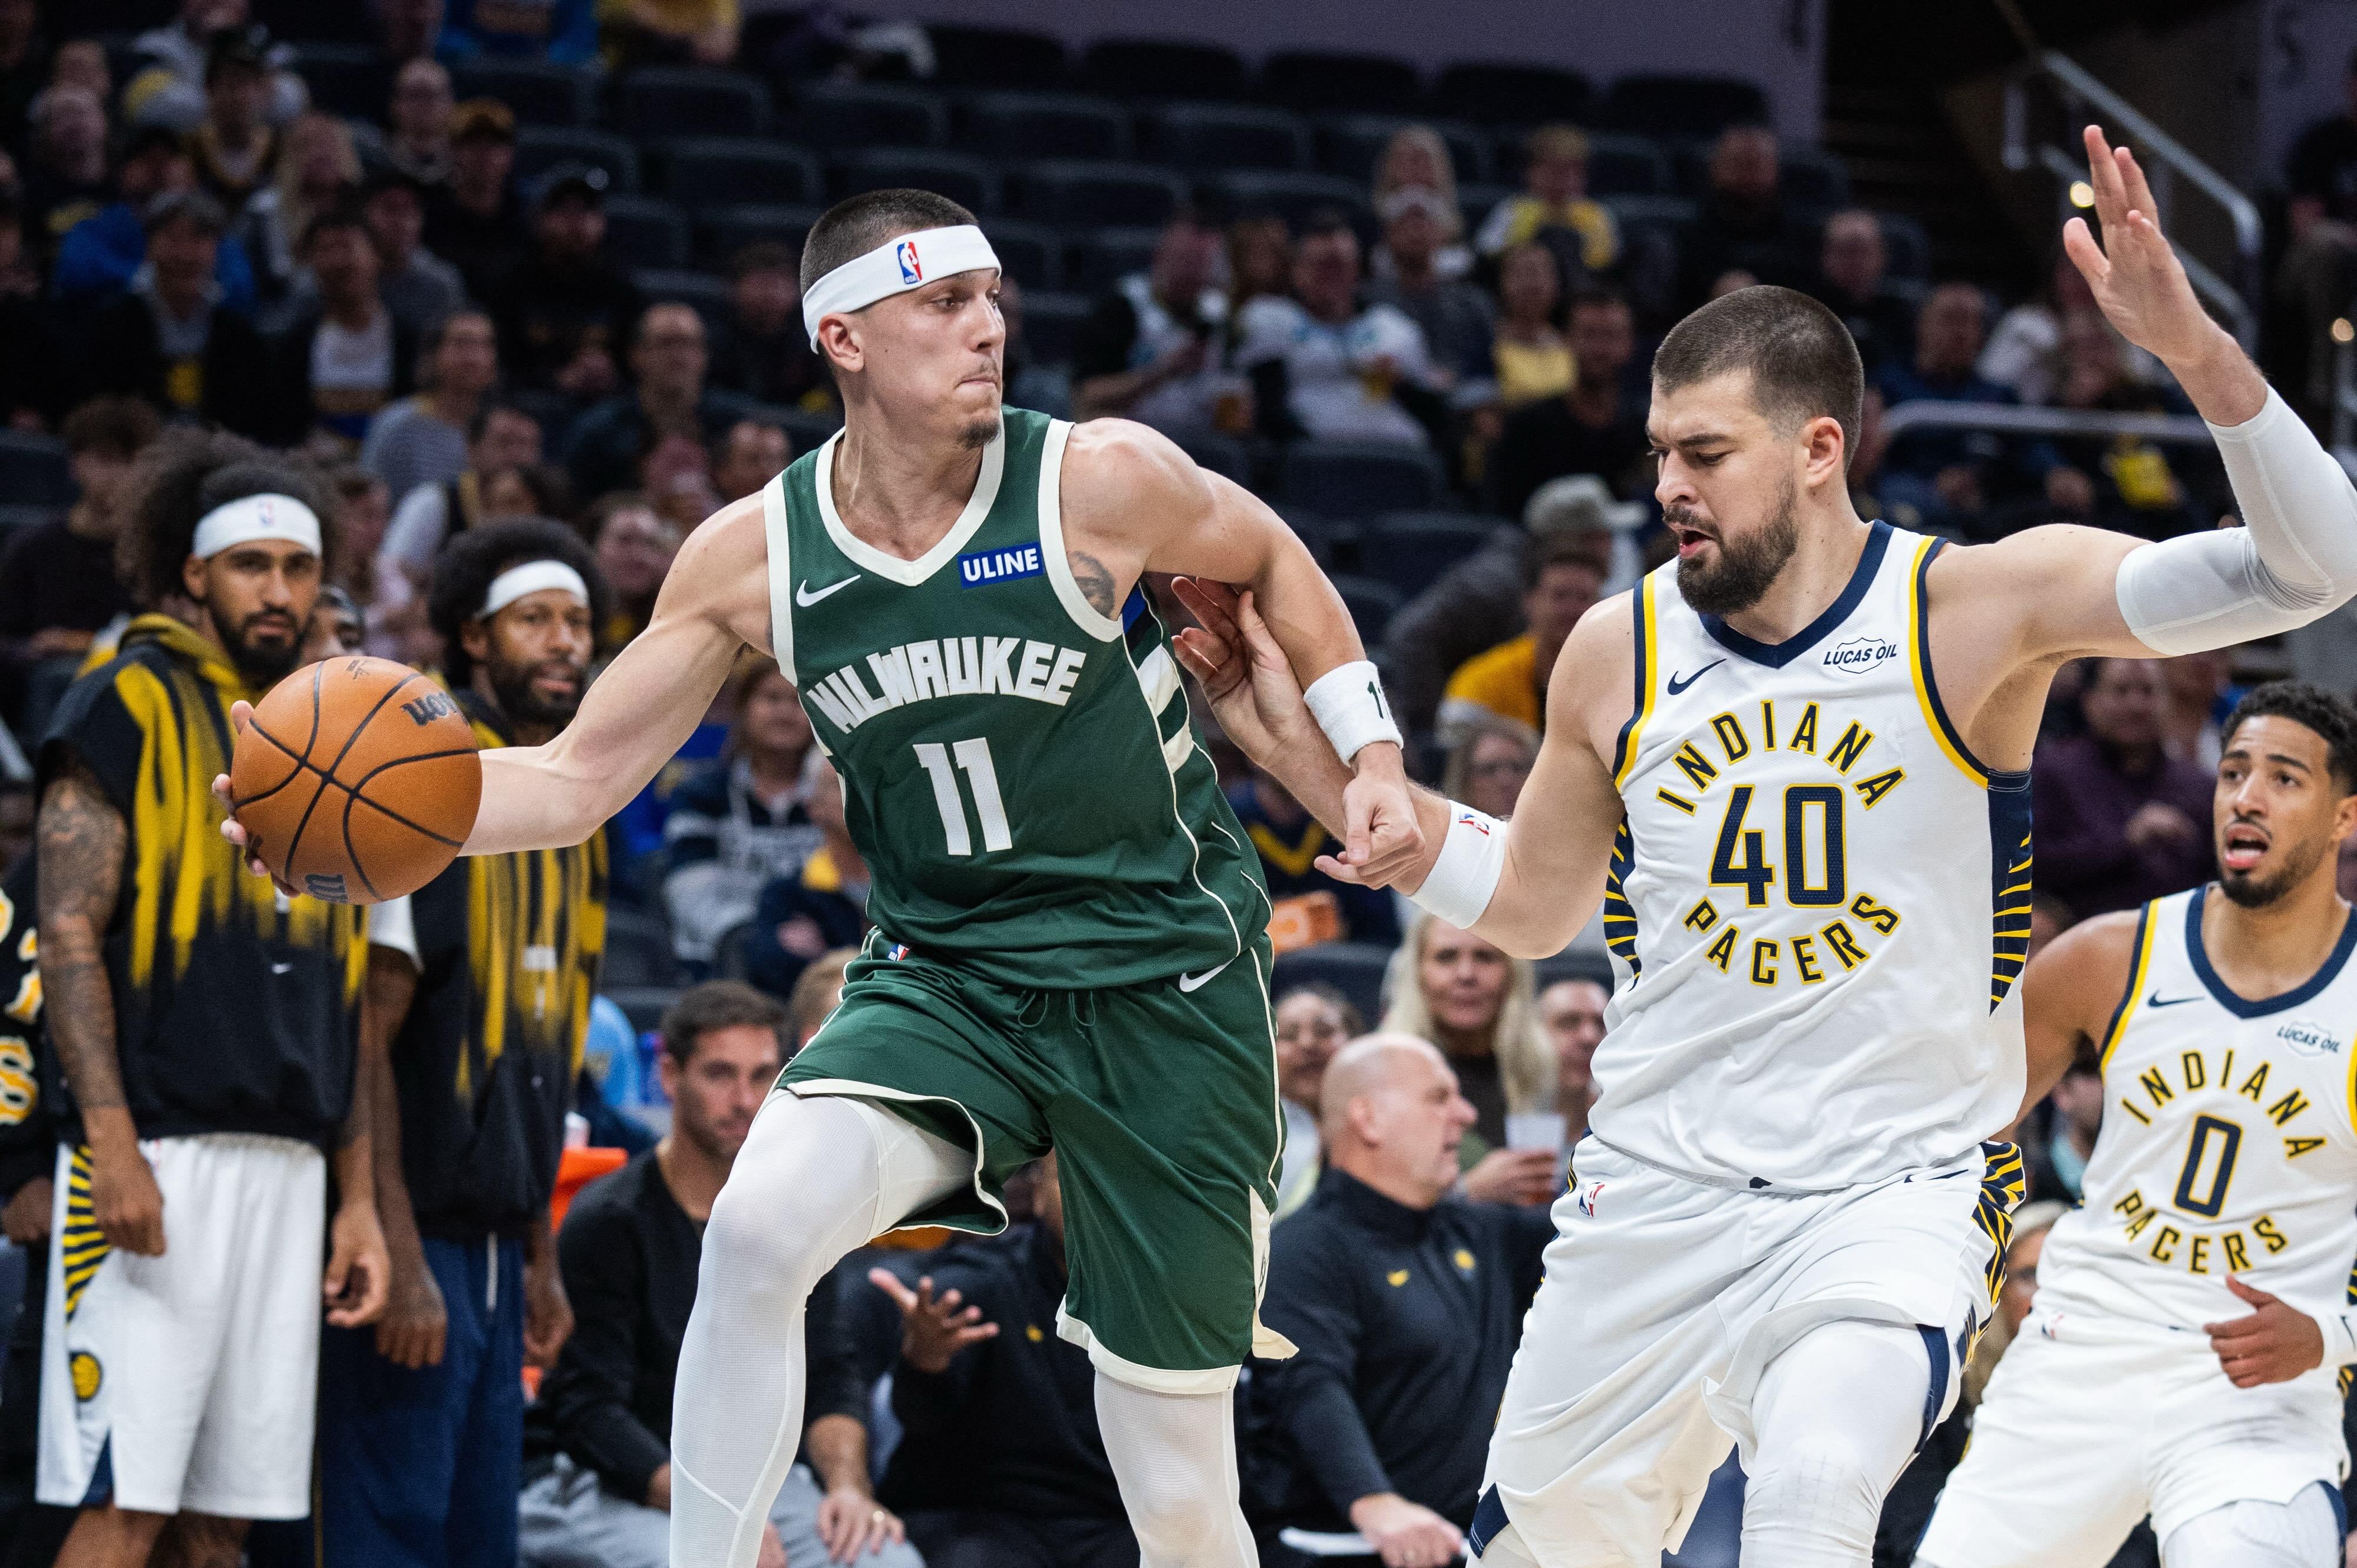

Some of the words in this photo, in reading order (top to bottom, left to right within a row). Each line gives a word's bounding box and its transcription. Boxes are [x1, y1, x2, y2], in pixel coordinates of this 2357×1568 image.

[963, 547, 1039, 582] ULINE
[806, 636, 1087, 734] MILWAUKEE
[1823, 648, 1873, 665] LUCAS
[1876, 644, 1897, 660] OIL
[913, 737, 1013, 856] 11
[1656, 699, 1907, 817] INDIANA
[1708, 783, 1848, 909] 40
[1684, 892, 1902, 987] PACERS
[2121, 1049, 2326, 1159] INDIANA
[2173, 1113, 2243, 1220] 0
[2114, 1190, 2288, 1274] PACERS
